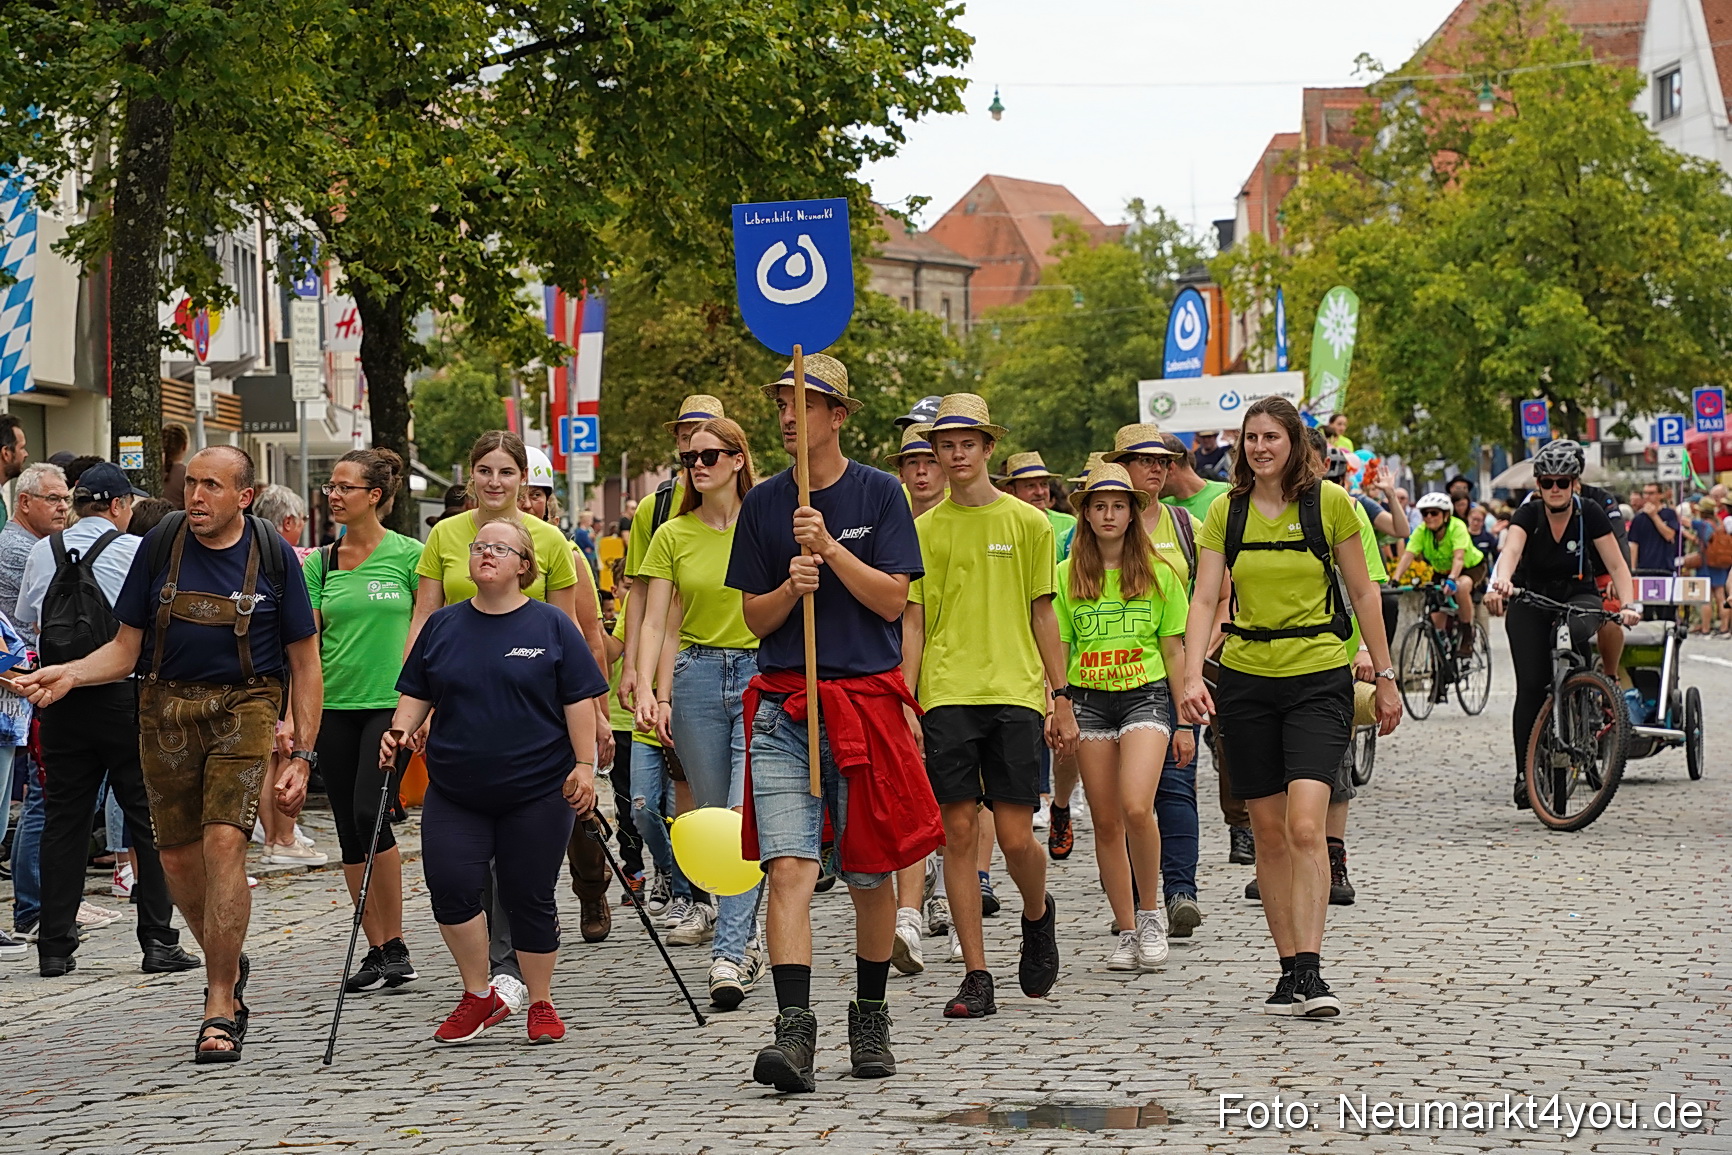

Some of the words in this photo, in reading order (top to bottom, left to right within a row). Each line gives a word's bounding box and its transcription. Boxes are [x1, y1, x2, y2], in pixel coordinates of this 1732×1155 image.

[745, 211, 793, 225] Lebenshilfe
[797, 208, 832, 221] Neumarkt
[244, 421, 291, 431] ESPRIT
[1662, 418, 1679, 443] P
[1699, 418, 1723, 430] TAXI
[571, 421, 590, 451] P
[368, 592, 400, 601] TEAM
[1080, 647, 1144, 668] MERZ
[1079, 662, 1146, 682] PREMIUM
